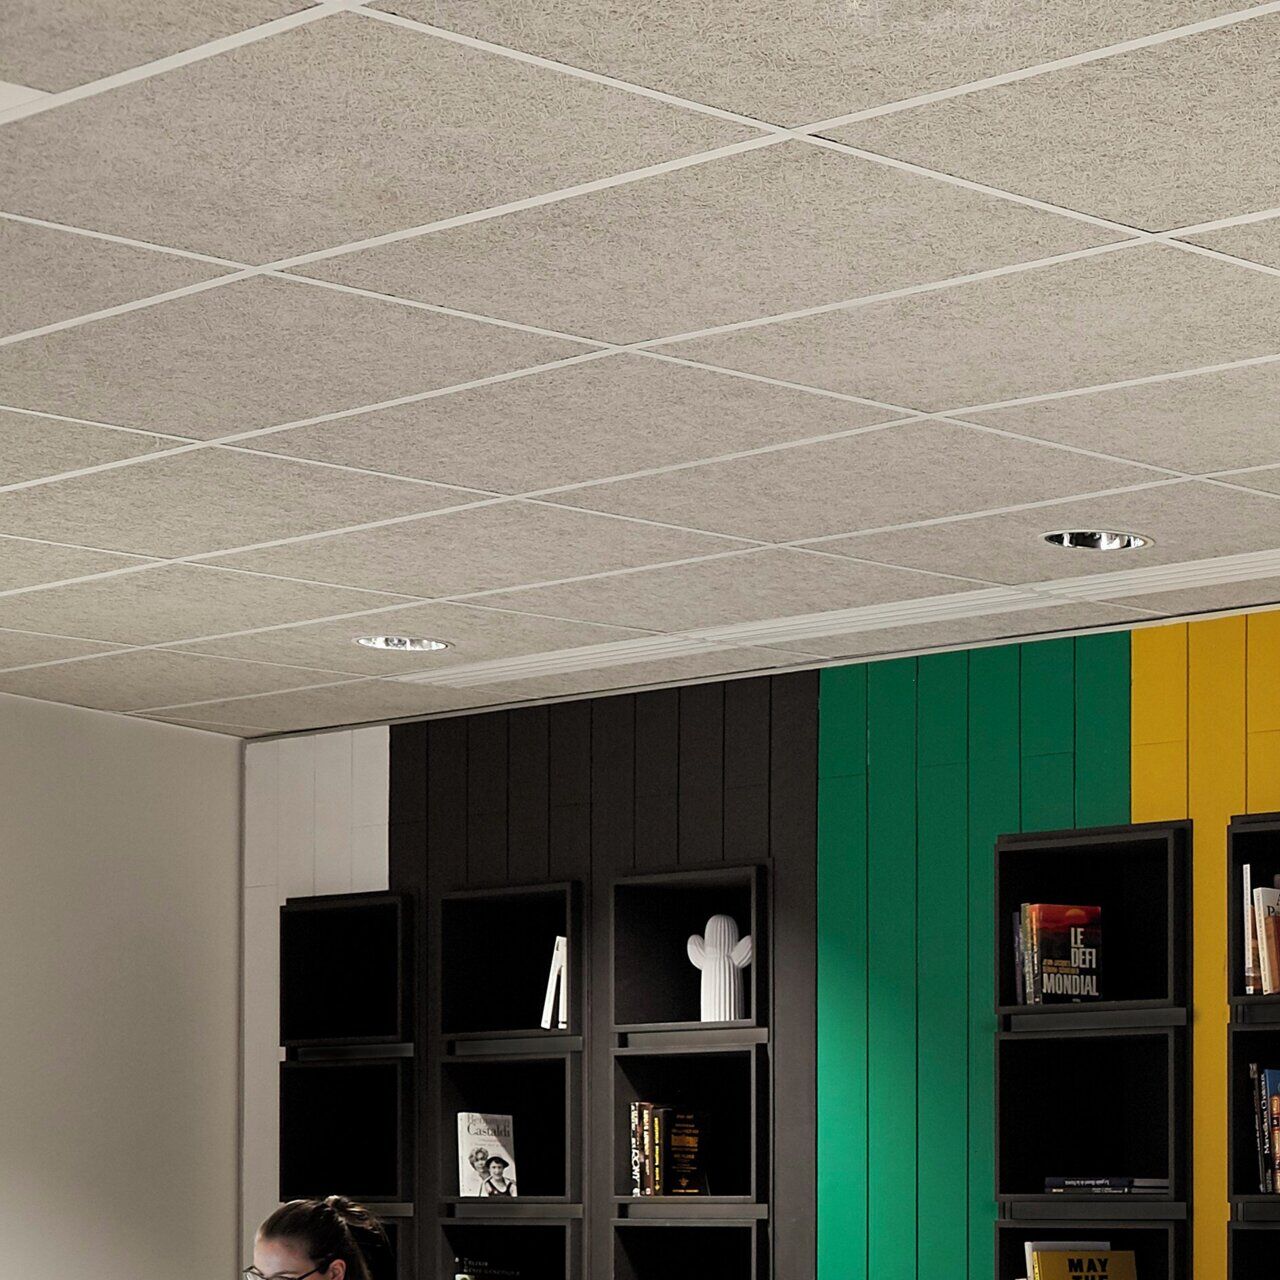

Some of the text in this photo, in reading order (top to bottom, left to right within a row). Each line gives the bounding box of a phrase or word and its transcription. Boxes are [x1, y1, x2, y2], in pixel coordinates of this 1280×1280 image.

[1071, 927, 1085, 948] LE
[1042, 973, 1099, 996] MONDIAL
[467, 1123, 510, 1137] Castaldi
[1067, 1258, 1108, 1273] MAY
